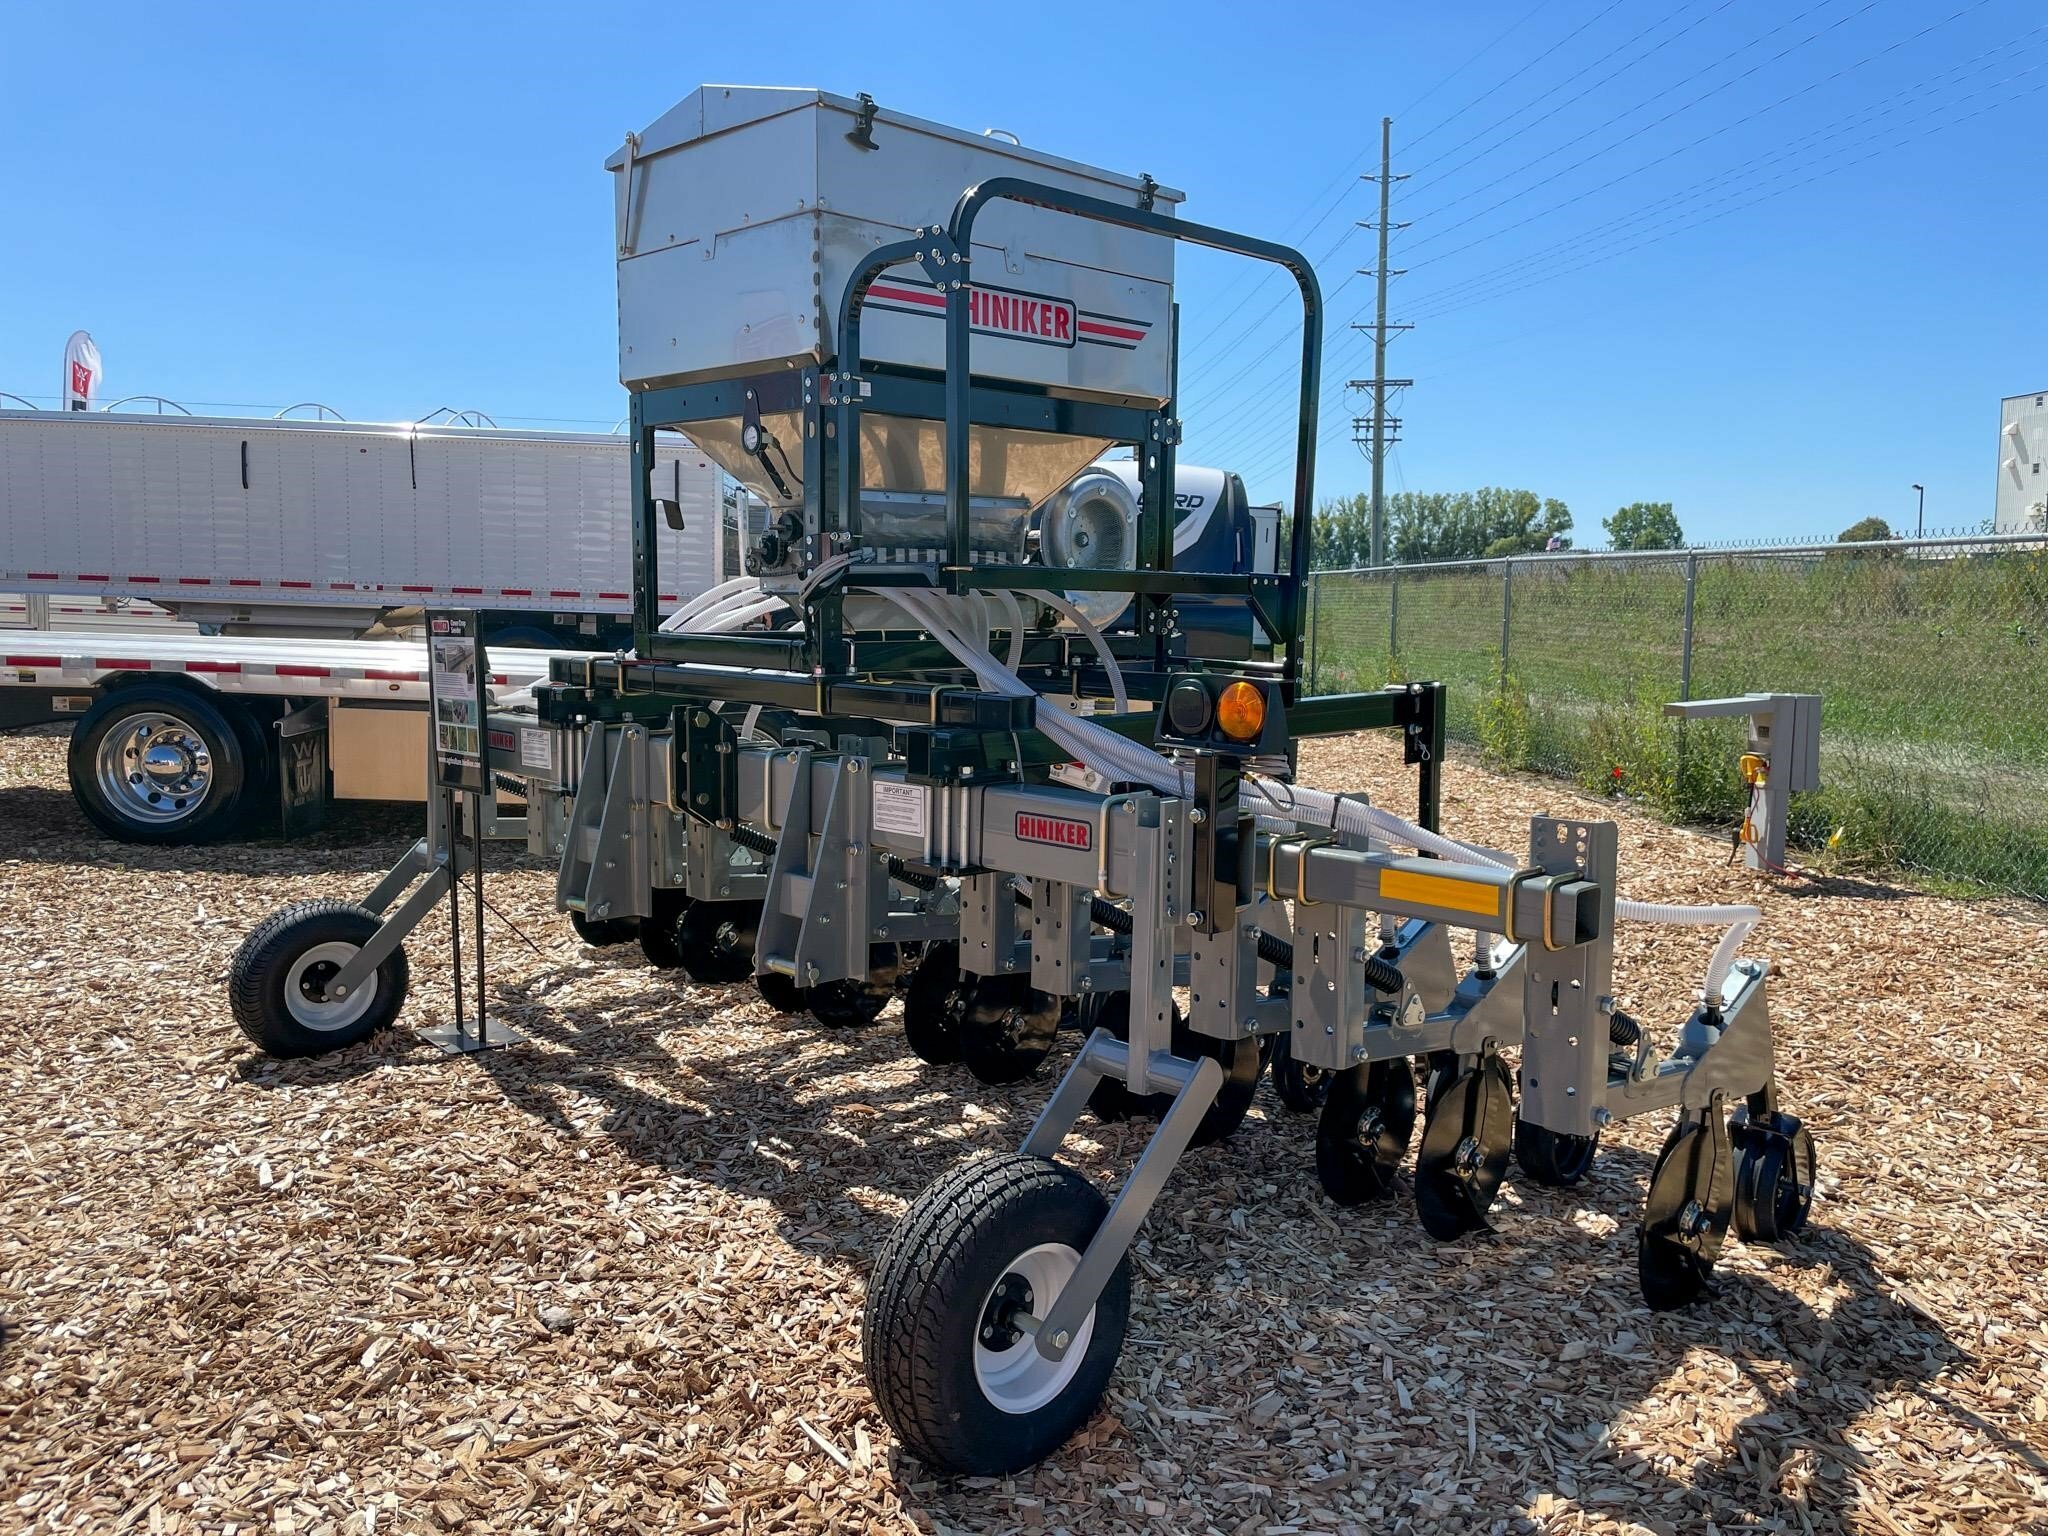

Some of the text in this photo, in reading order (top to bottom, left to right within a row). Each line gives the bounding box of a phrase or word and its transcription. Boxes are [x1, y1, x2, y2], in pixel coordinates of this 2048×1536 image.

[969, 290, 1070, 340] HINIKER
[882, 786, 913, 797] IMPORTANT
[1018, 815, 1088, 847] HINIKER
